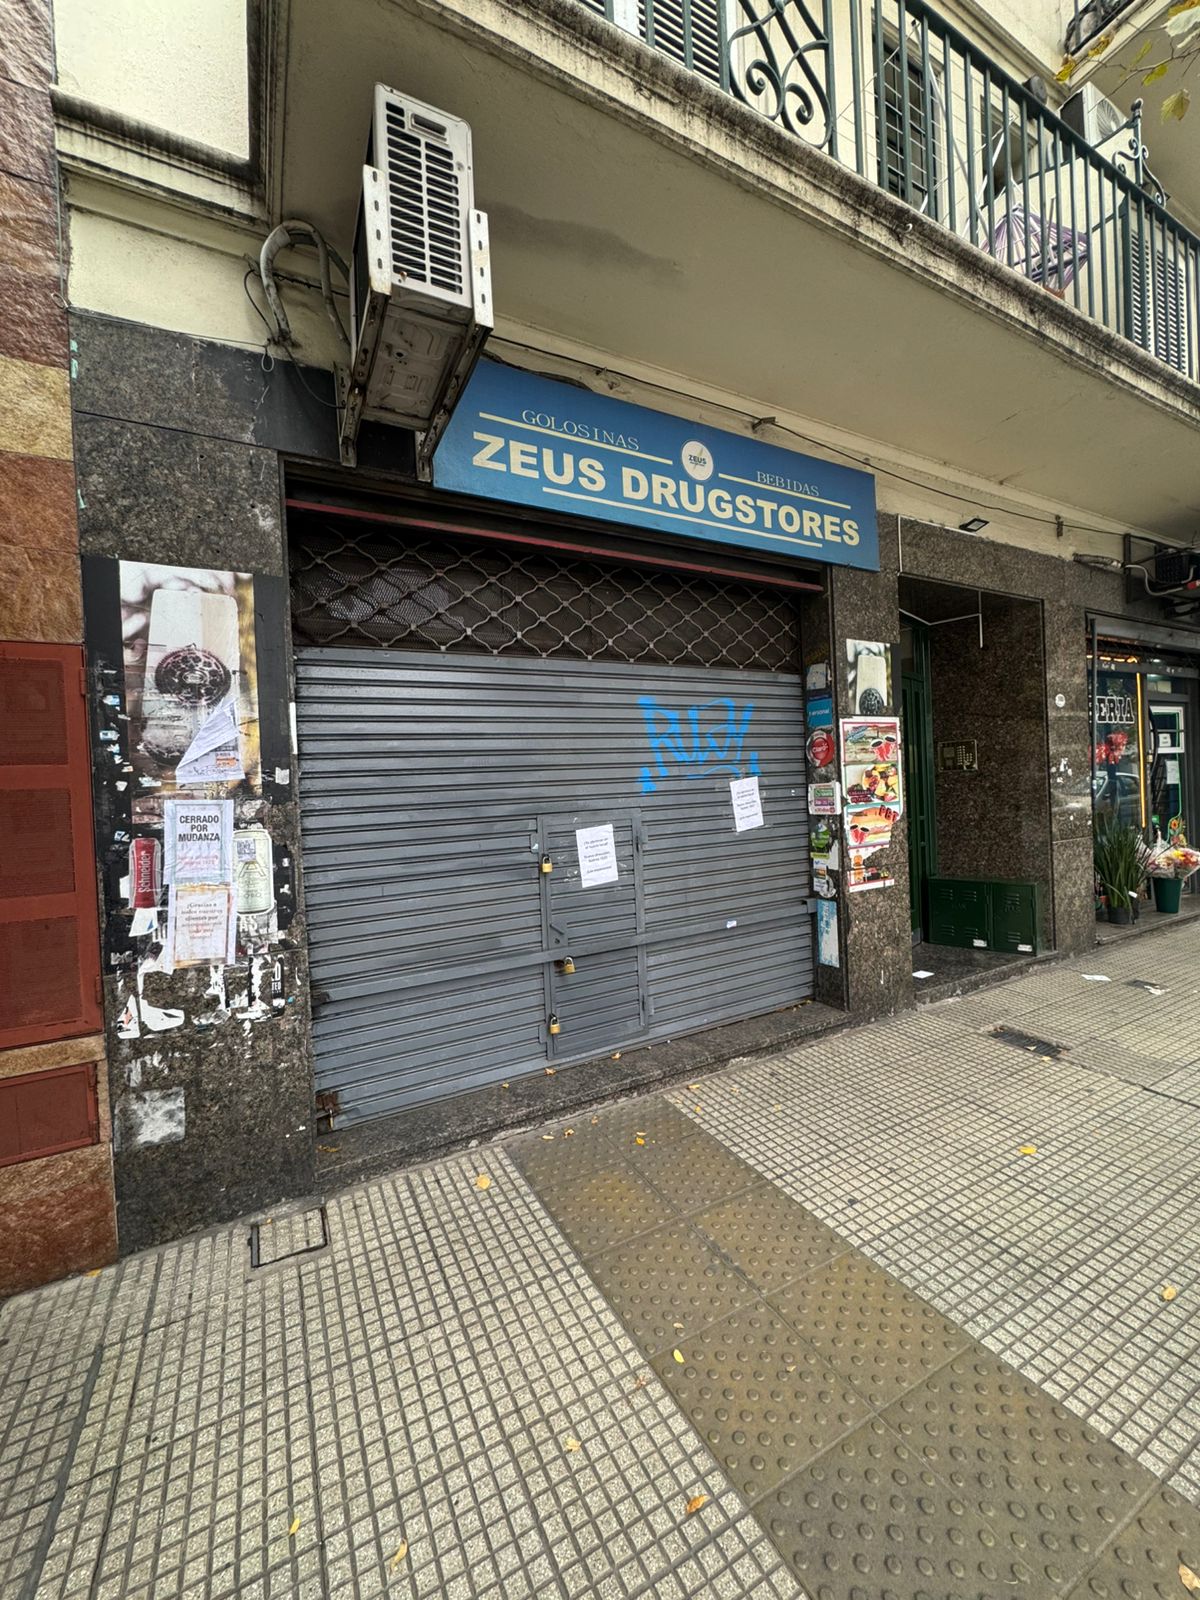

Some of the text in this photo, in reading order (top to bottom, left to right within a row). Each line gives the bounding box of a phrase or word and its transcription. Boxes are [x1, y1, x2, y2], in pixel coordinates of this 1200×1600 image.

[521, 409, 640, 451] GOLOSINAS
[688, 454, 707, 465] ZEUS
[472, 431, 860, 547] ZEUS DRUGSTORES
[756, 470, 820, 497] BEBIDAS
[179, 815, 220, 824] CERRADO
[190, 824, 208, 832] POR
[178, 833, 221, 842] MUDANZA
[138, 850, 152, 893] Schneider
